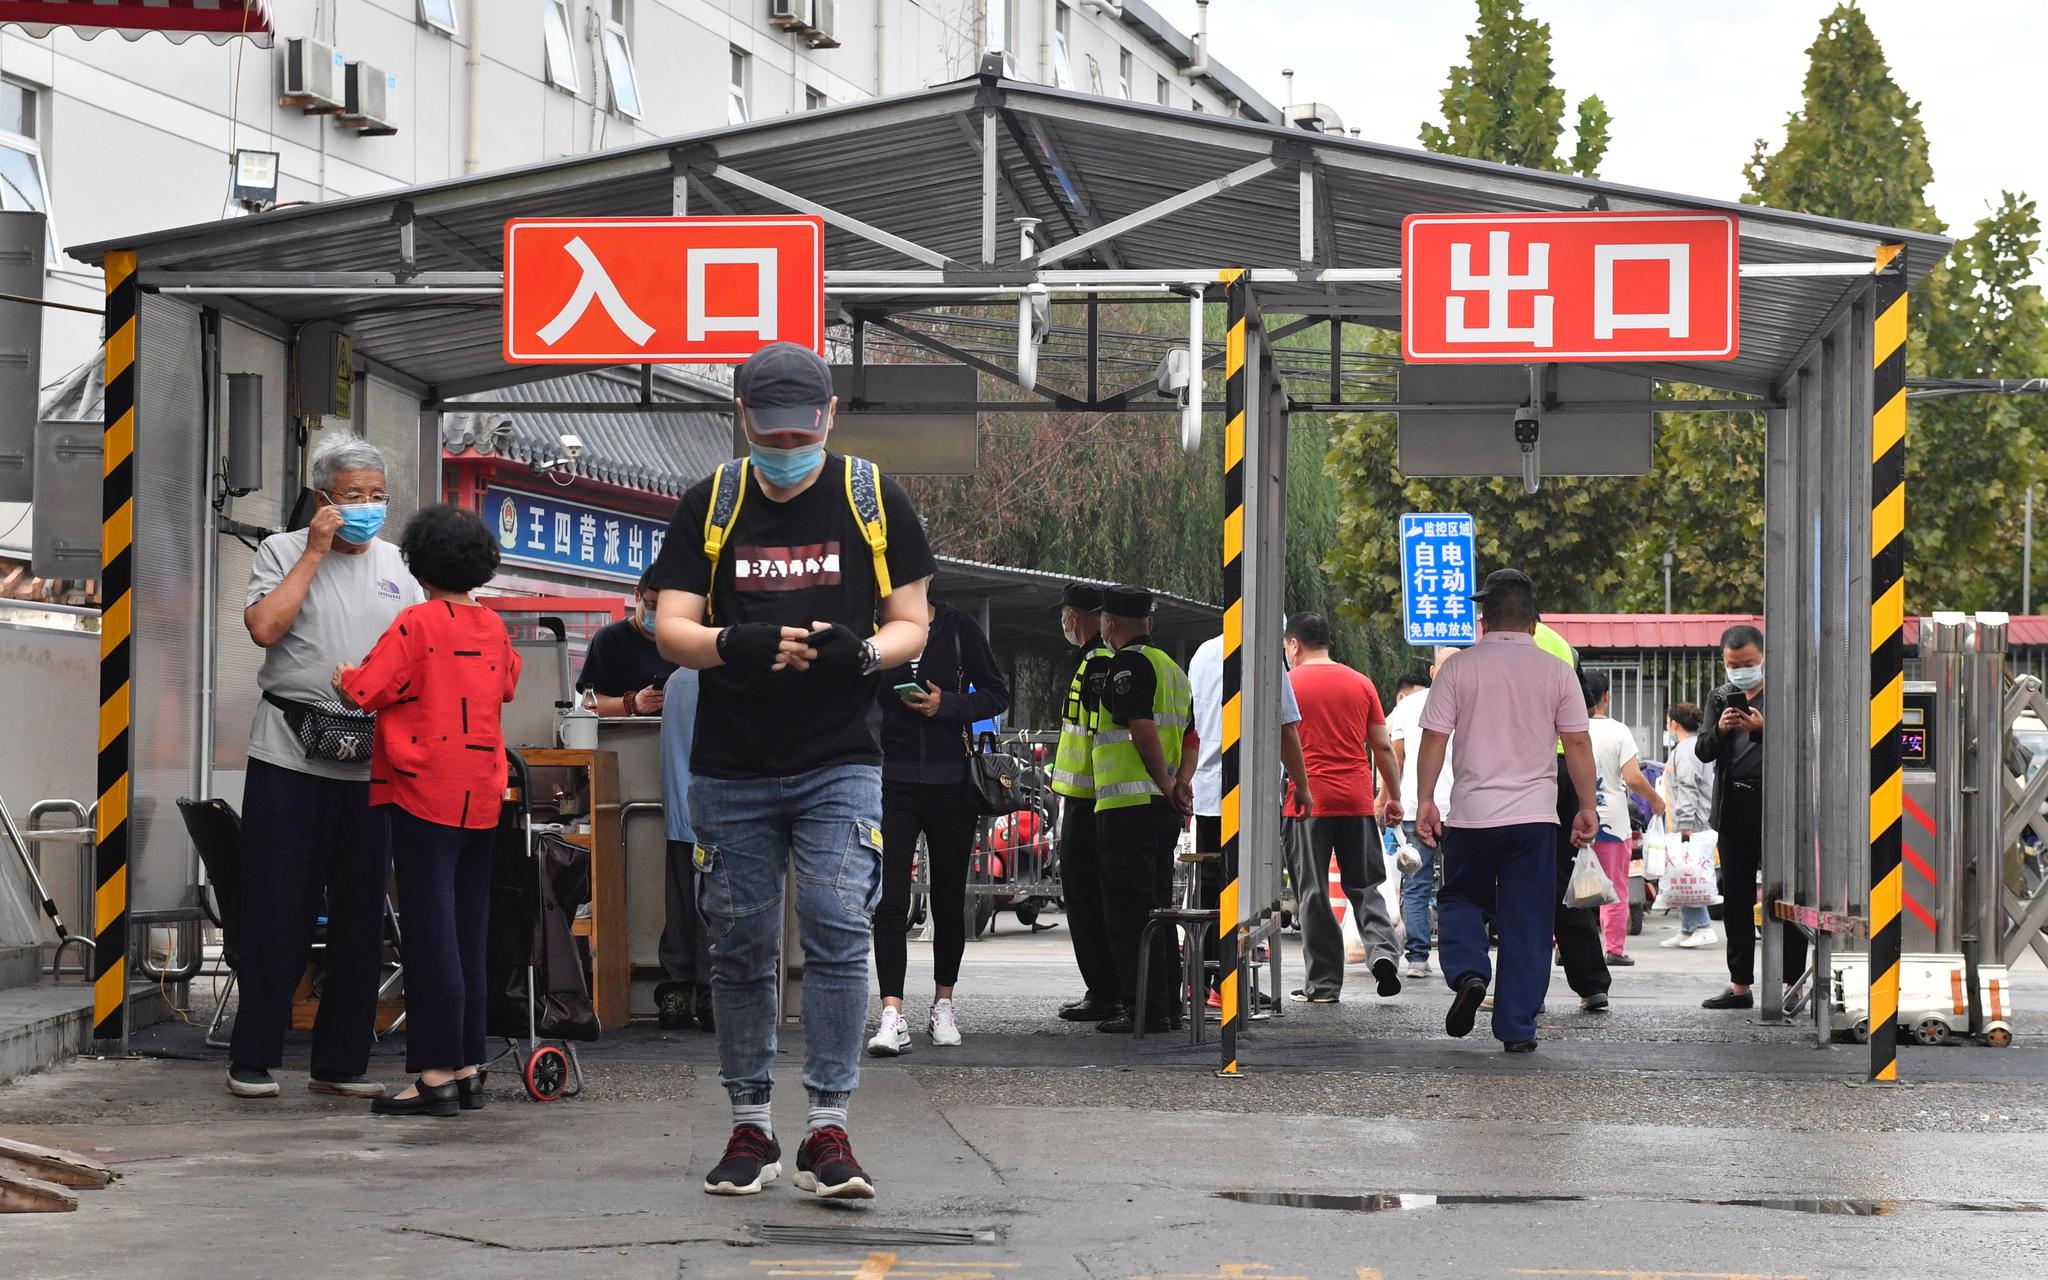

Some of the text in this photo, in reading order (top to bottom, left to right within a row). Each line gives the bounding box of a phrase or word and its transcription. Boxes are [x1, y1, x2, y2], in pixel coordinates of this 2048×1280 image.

[535, 236, 778, 347] 入口
[1445, 231, 1690, 347] 出口
[1424, 521, 1470, 537] 监控区域
[1410, 622, 1473, 637] 免费停放处
